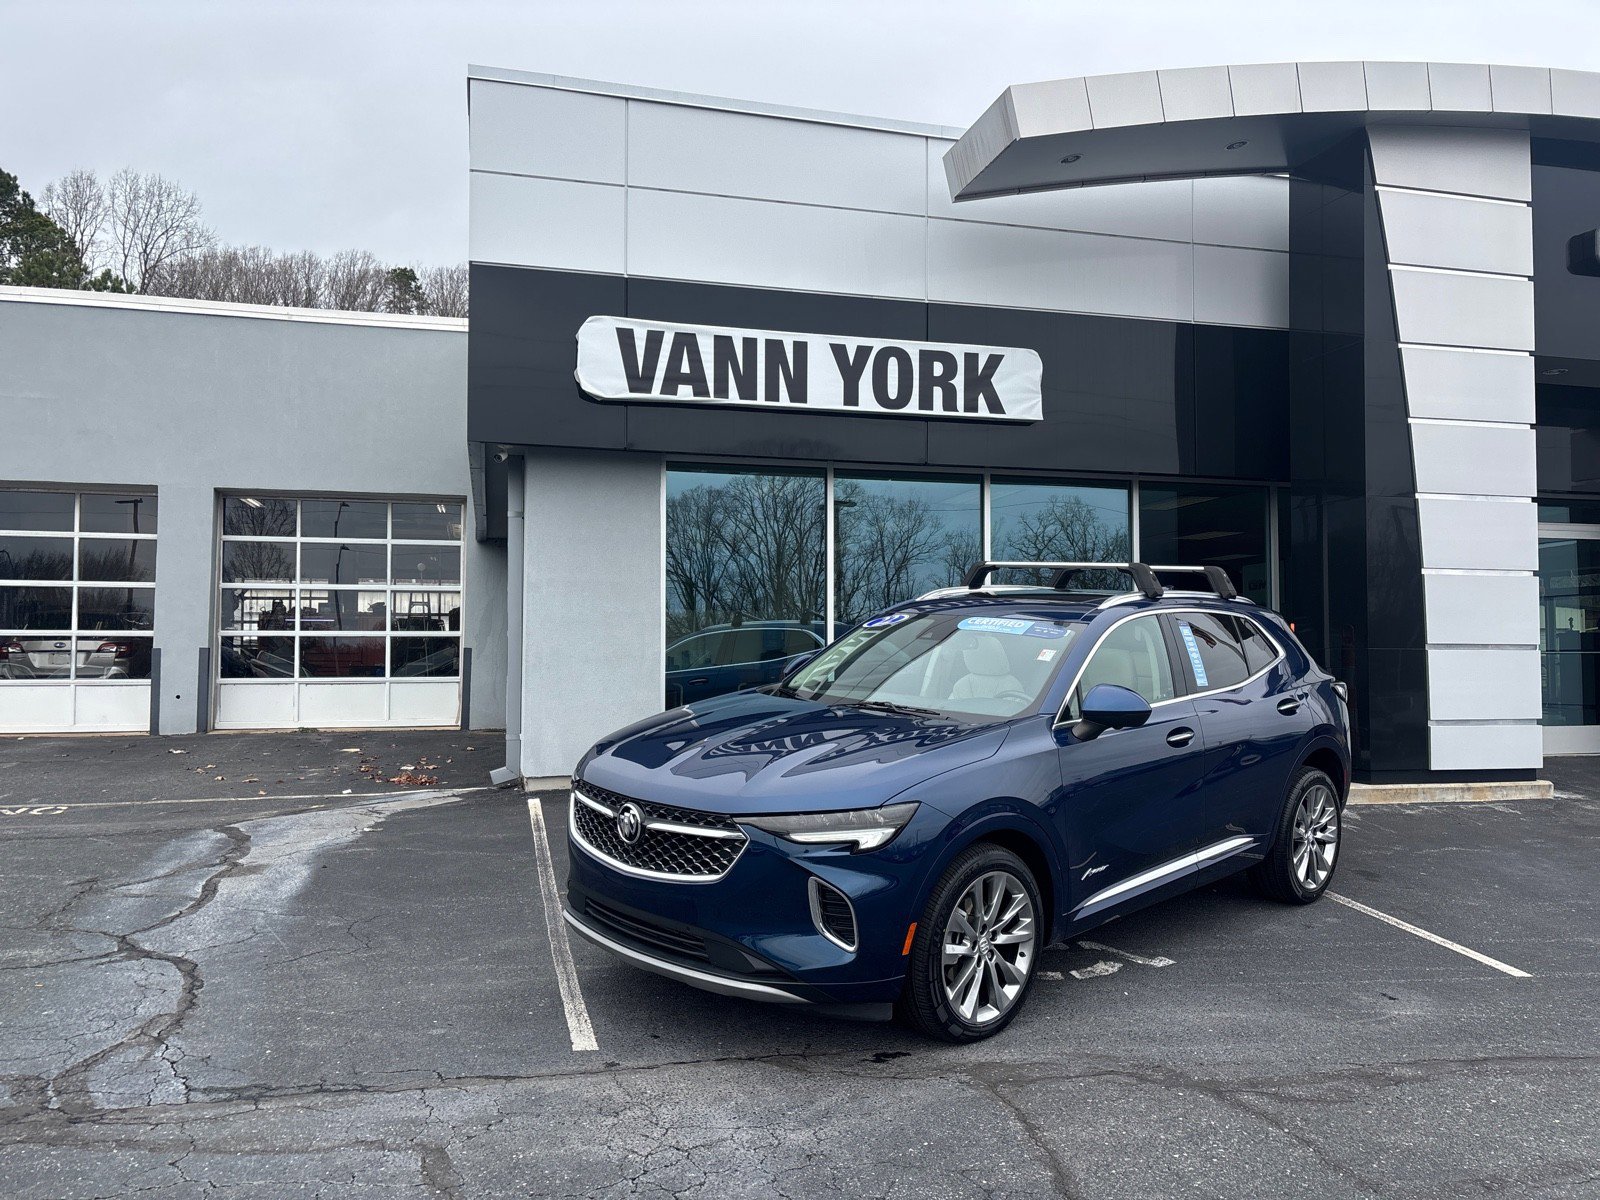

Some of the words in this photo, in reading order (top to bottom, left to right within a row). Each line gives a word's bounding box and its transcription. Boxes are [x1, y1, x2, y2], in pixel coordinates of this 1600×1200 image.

[615, 327, 808, 404] VANN
[829, 343, 1006, 415] YORK
[967, 617, 1025, 628] CERTIFIED
